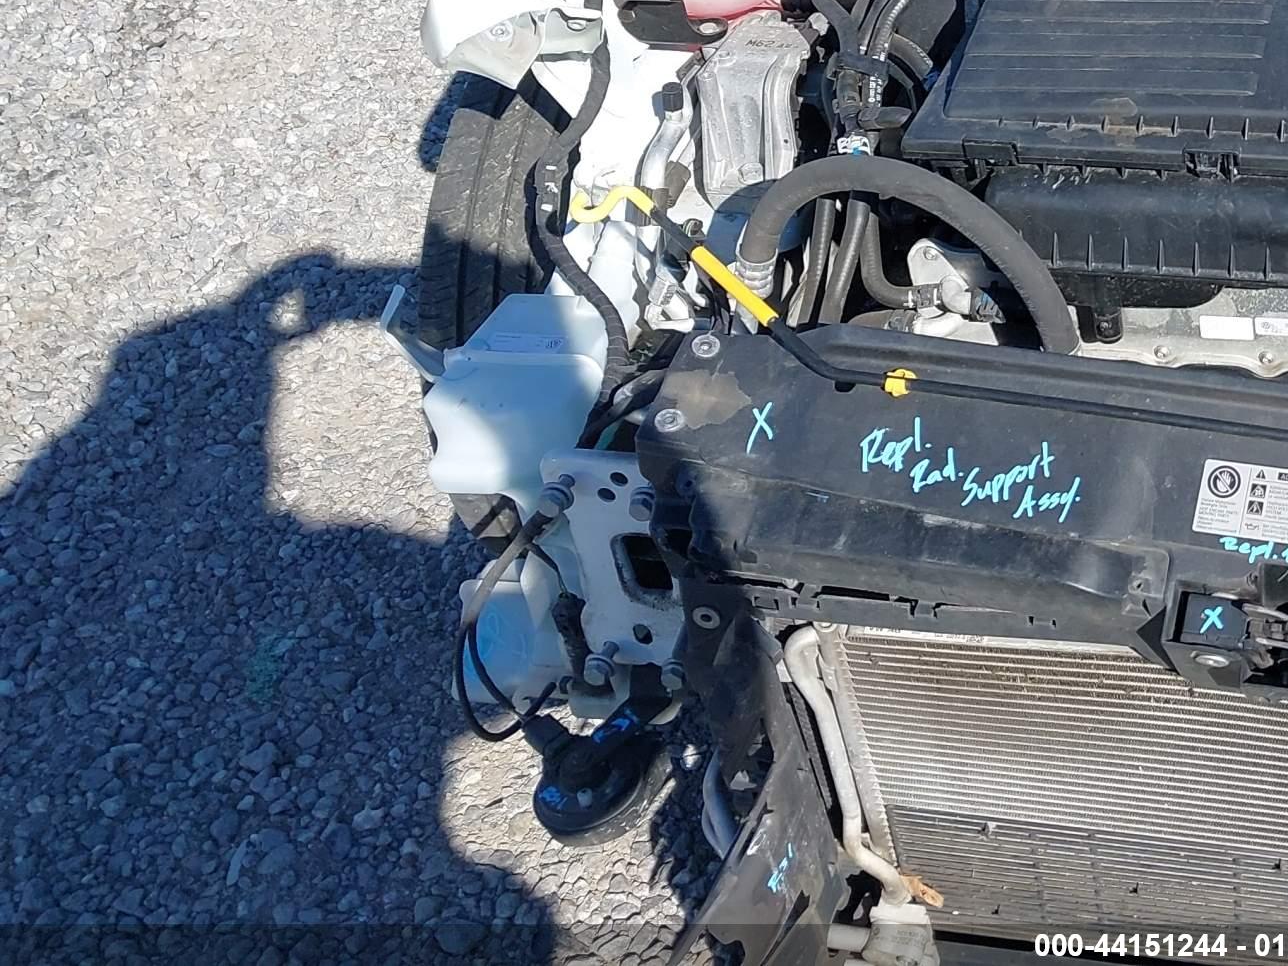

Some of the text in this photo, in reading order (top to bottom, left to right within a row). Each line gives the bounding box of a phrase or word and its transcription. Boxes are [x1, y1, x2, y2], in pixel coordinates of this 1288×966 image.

[745, 401, 774, 455] X
[860, 416, 933, 472] Repl.
[961, 441, 1056, 507] Support
[1219, 536, 1279, 564] Repl.
[1199, 605, 1225, 634] X
